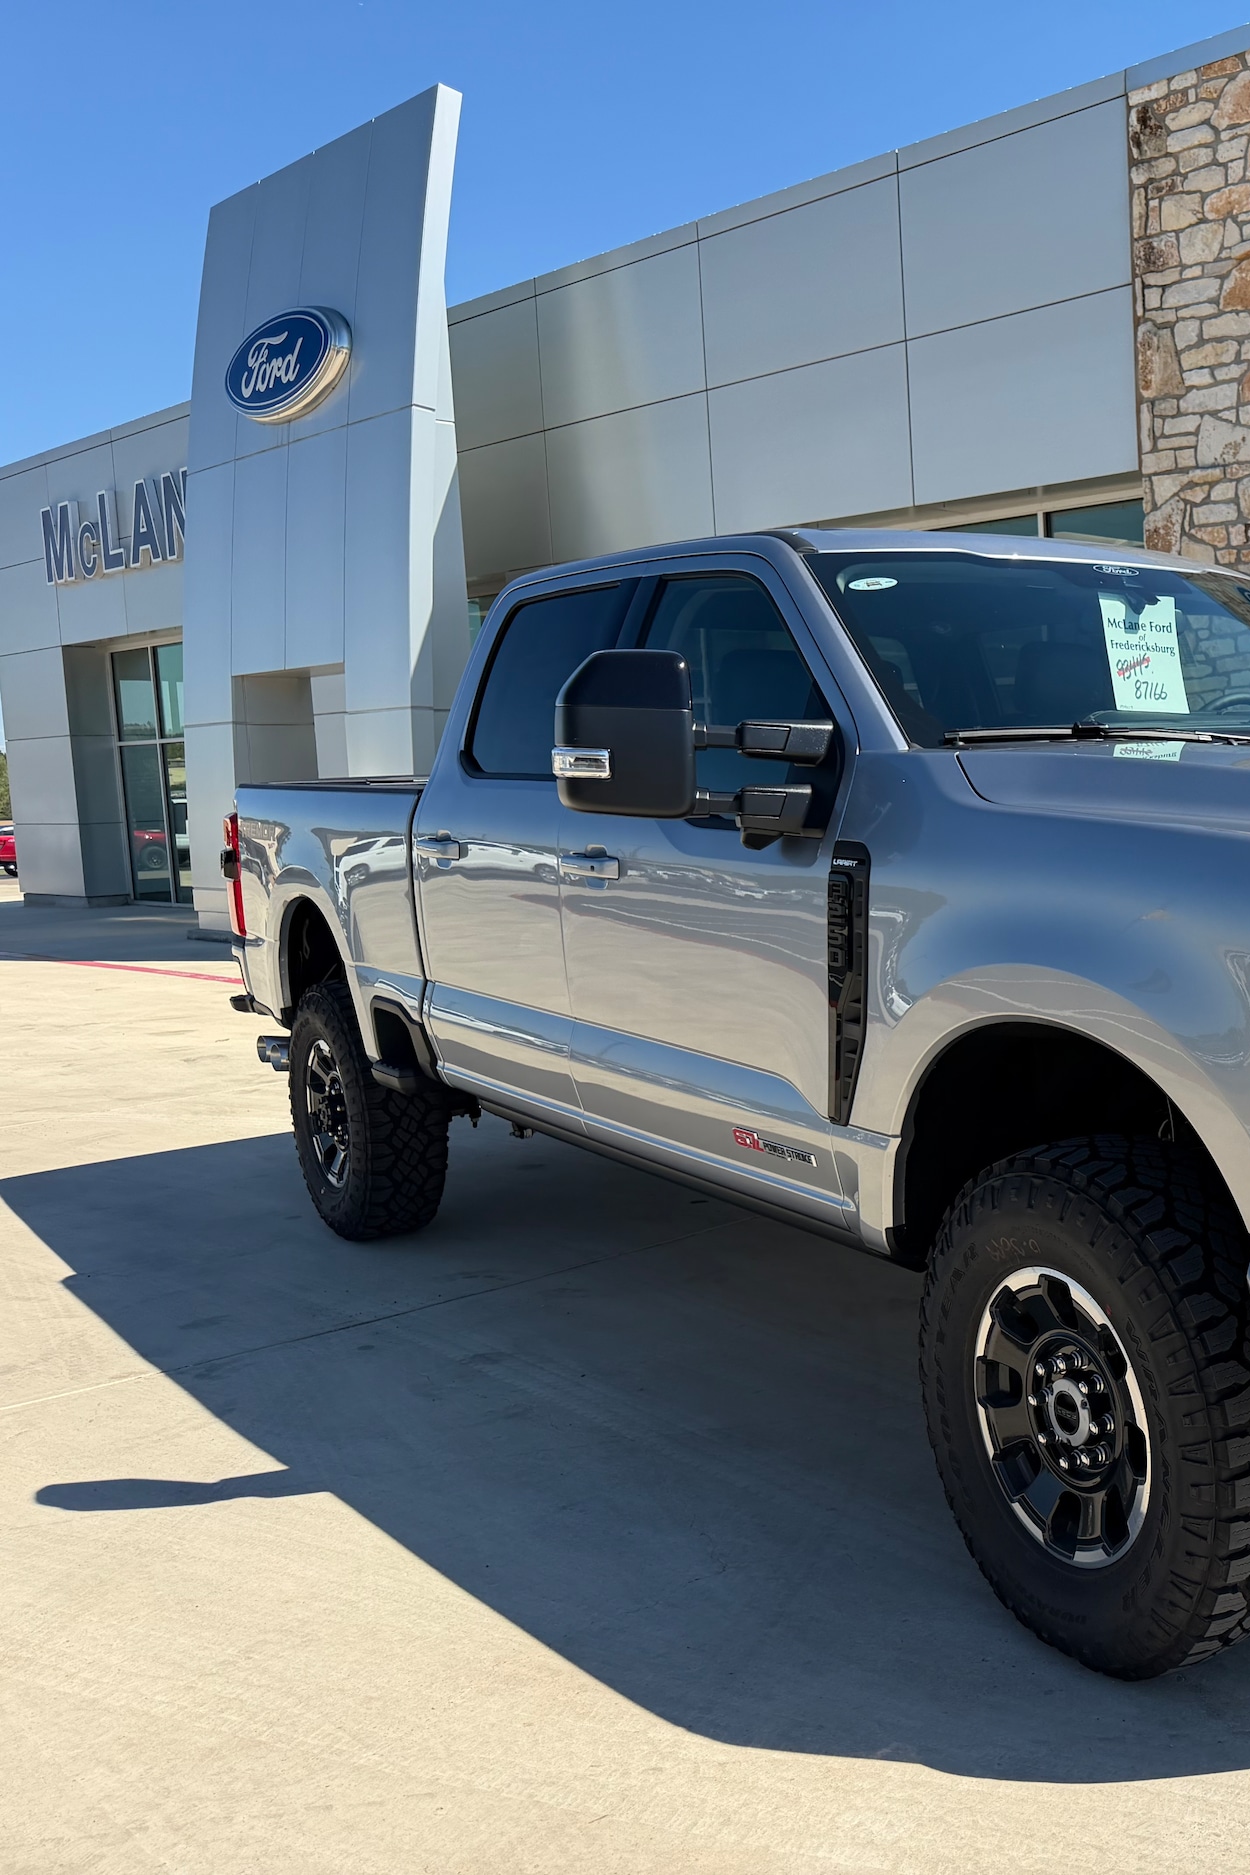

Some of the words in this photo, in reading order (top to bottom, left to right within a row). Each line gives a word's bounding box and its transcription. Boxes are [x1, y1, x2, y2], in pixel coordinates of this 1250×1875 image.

[241, 331, 304, 399] Ford
[1107, 617, 1147, 631] McLane
[1149, 621, 1173, 634] Ford
[1138, 633, 1147, 642] of
[1110, 639, 1176, 657] Fredericksburg
[1135, 679, 1168, 701] 87166
[762, 1141, 787, 1157] POWER
